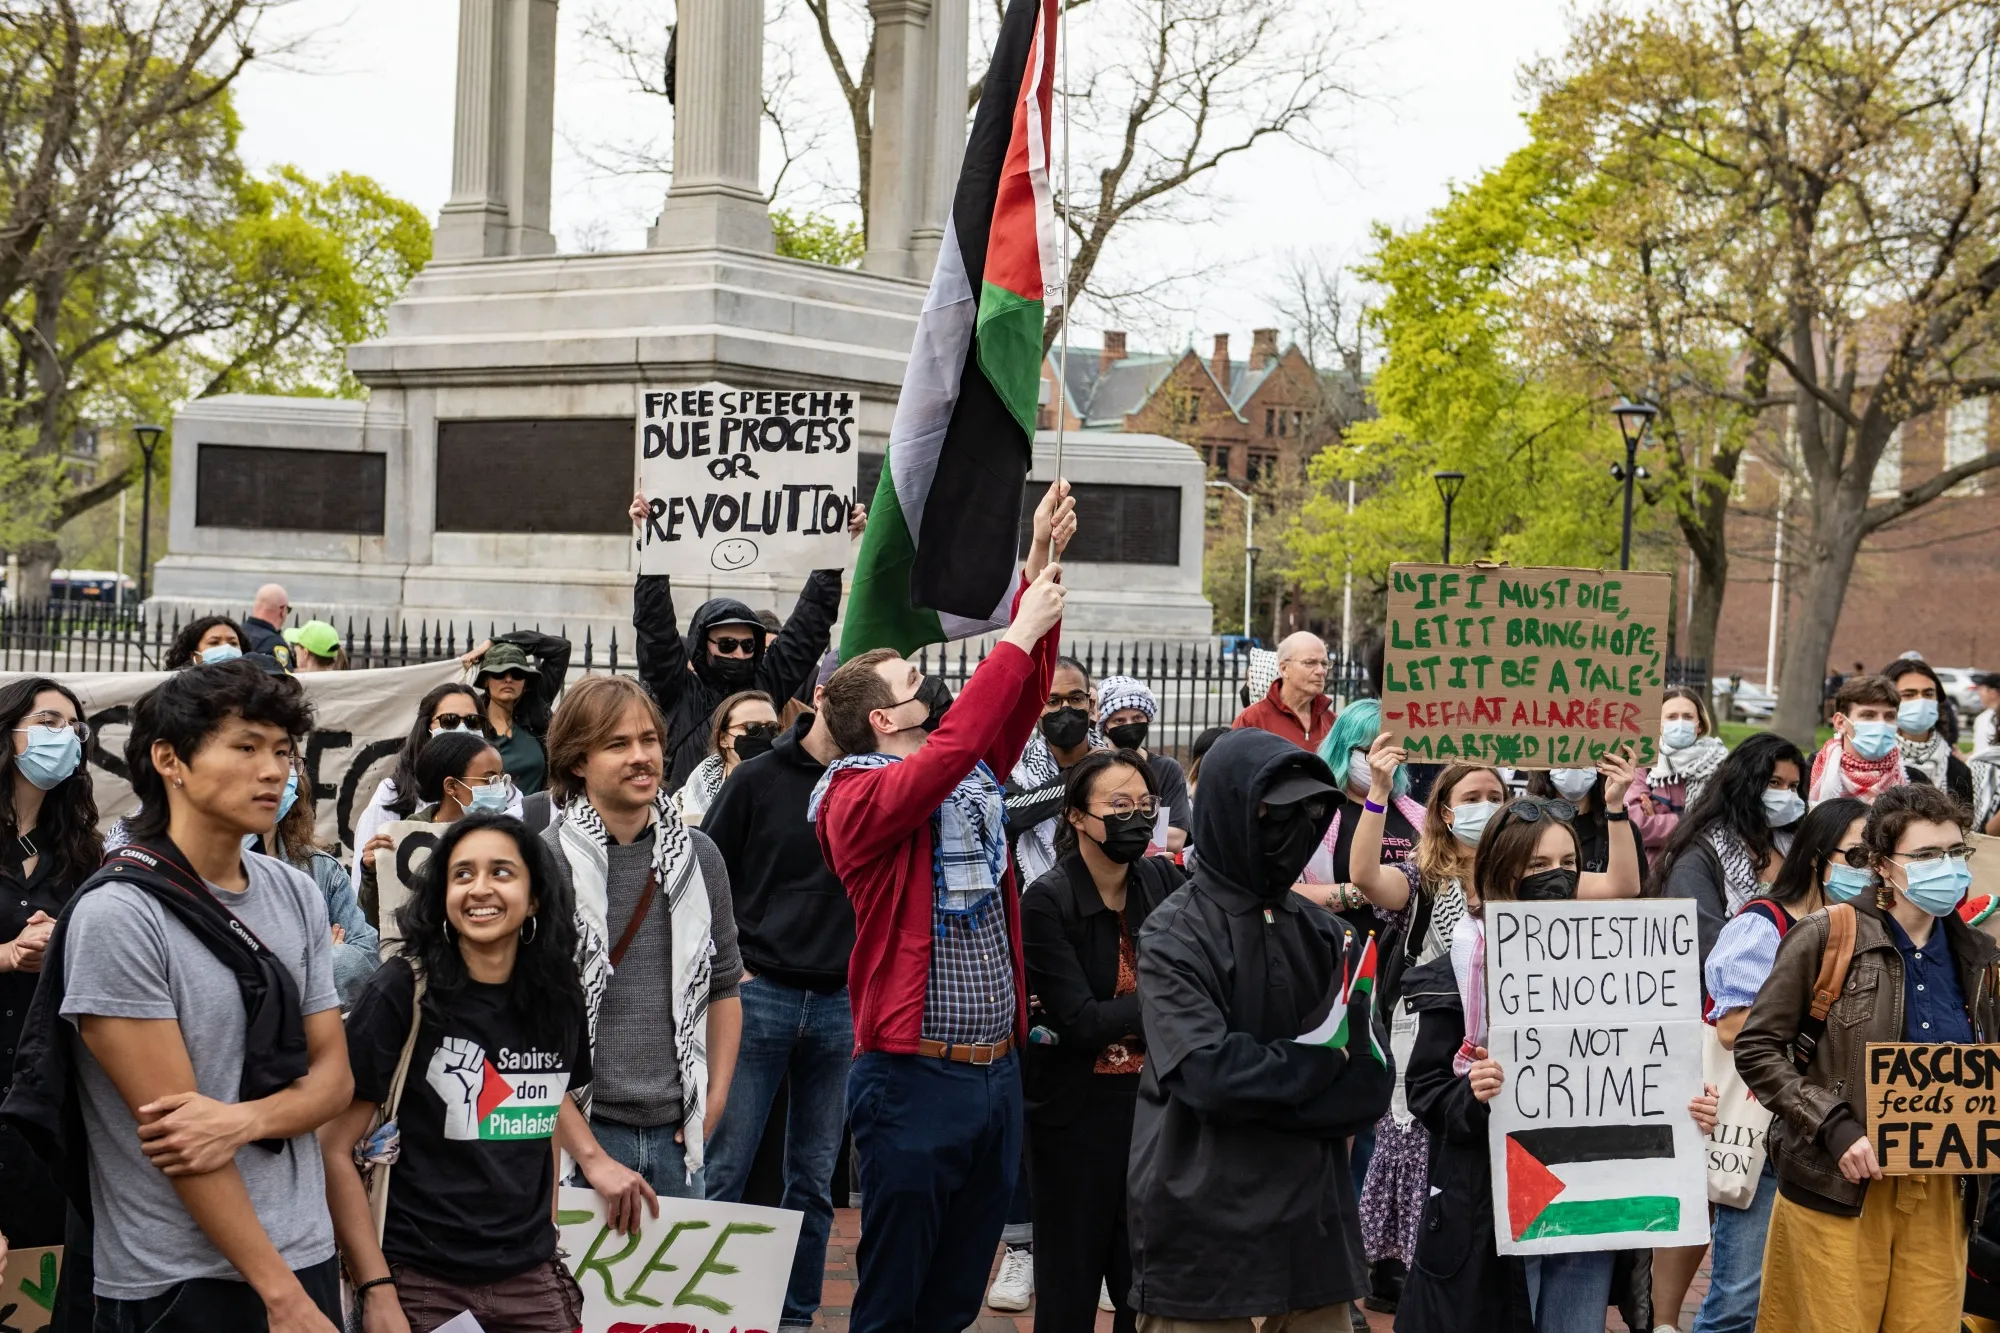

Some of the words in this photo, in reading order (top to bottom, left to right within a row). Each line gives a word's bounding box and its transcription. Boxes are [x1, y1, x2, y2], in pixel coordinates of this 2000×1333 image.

[645, 390, 713, 419] FREE
[643, 421, 711, 459] DUE
[718, 416, 855, 455] PROCESS
[707, 453, 760, 481] OR
[646, 484, 856, 545] REVOLUTION
[1464, 575, 1487, 609] I
[1499, 578, 1571, 610] MUST
[1577, 580, 1629, 621] DIE,
[1391, 613, 1449, 650] LET
[1455, 615, 1496, 648] IT
[1506, 617, 1587, 650] BRING
[1591, 623, 1660, 667] HOPE,
[1386, 655, 1441, 692] LET
[1448, 655, 1495, 689] IT
[1501, 655, 1540, 688] BE
[1548, 659, 1570, 694] A
[119, 849, 158, 867] Canon
[1381, 837, 1412, 847] EERS
[229, 919, 260, 951] Canon
[1497, 912, 1694, 968] PROTESTING
[1499, 970, 1678, 1015] GENOCIDE
[1513, 1027, 1542, 1062] IS
[1569, 1028, 1628, 1058] NOT
[1649, 1025, 1668, 1057] A
[516, 1080, 547, 1100] don
[1515, 1064, 1665, 1119] CRIME
[1876, 1087, 1954, 1119] feeds
[1964, 1095, 1997, 1115] on
[1705, 1148, 1755, 1176] SON
[1877, 1120, 2000, 1169] FEAR
